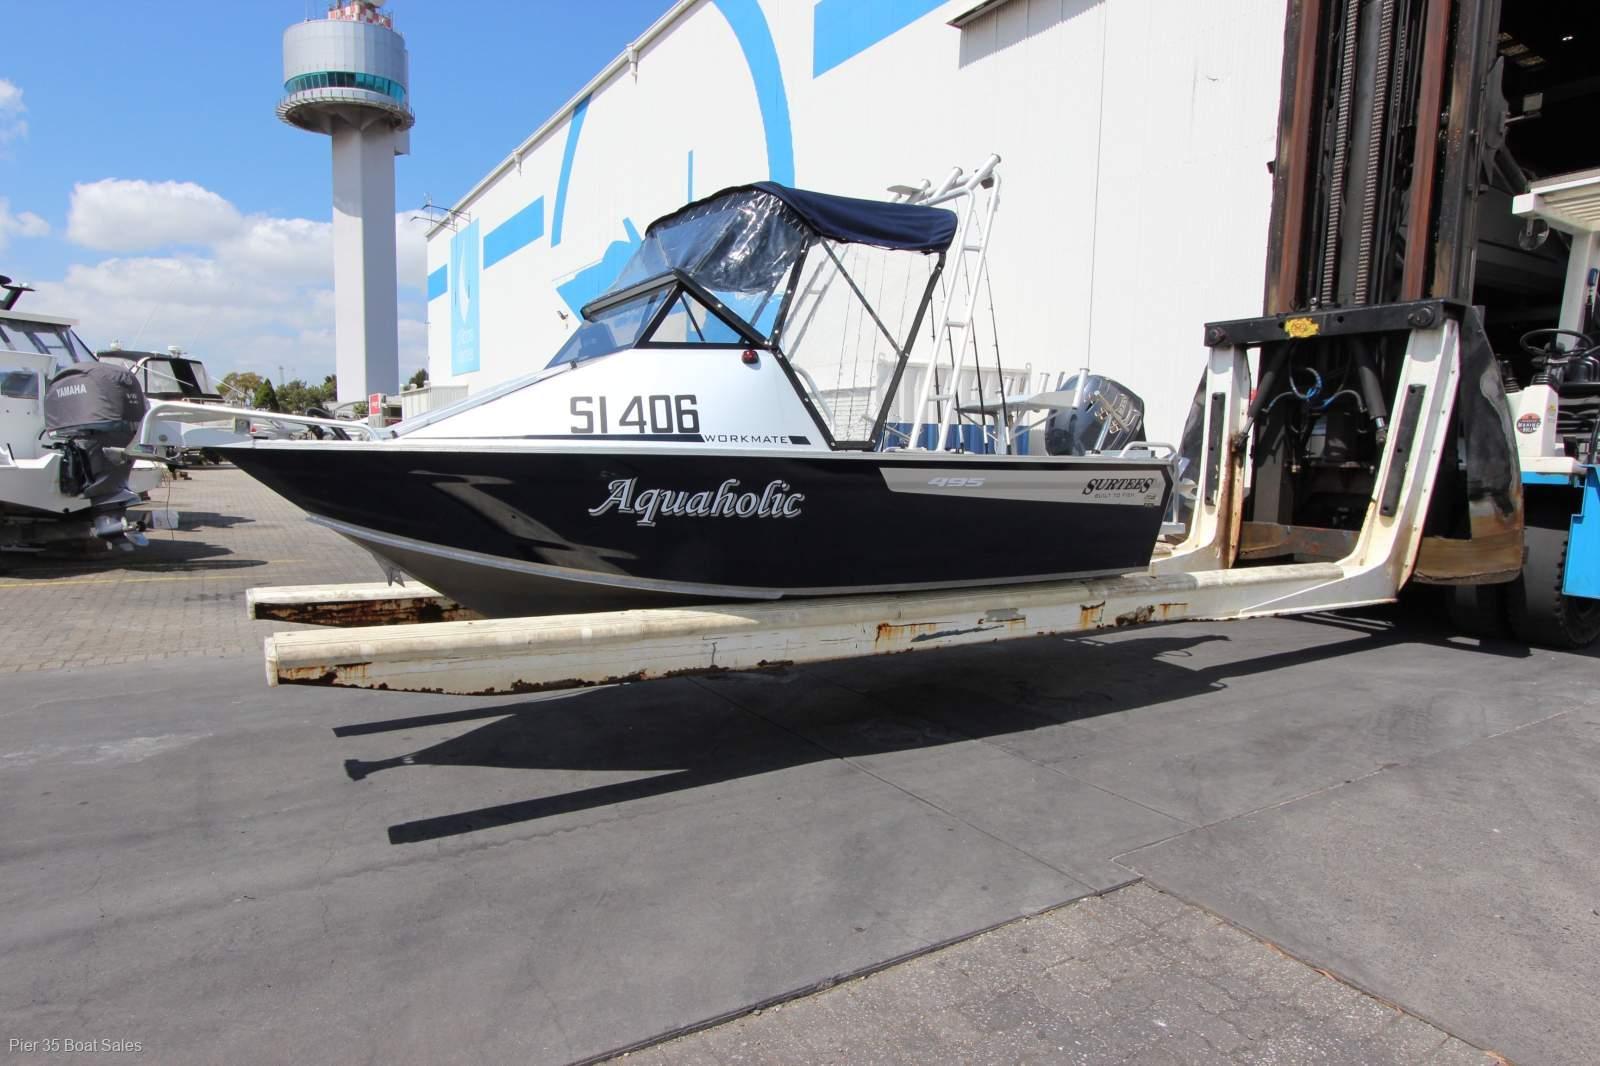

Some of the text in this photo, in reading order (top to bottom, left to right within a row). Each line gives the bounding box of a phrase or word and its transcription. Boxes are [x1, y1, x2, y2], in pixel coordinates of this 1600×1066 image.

[56, 383, 87, 398] YAMAHA
[569, 394, 701, 434] SI 406
[704, 434, 789, 444] WORKMATE
[928, 477, 985, 487] 495
[1082, 478, 1154, 495] SURTEES
[588, 477, 805, 527] Aquaholic
